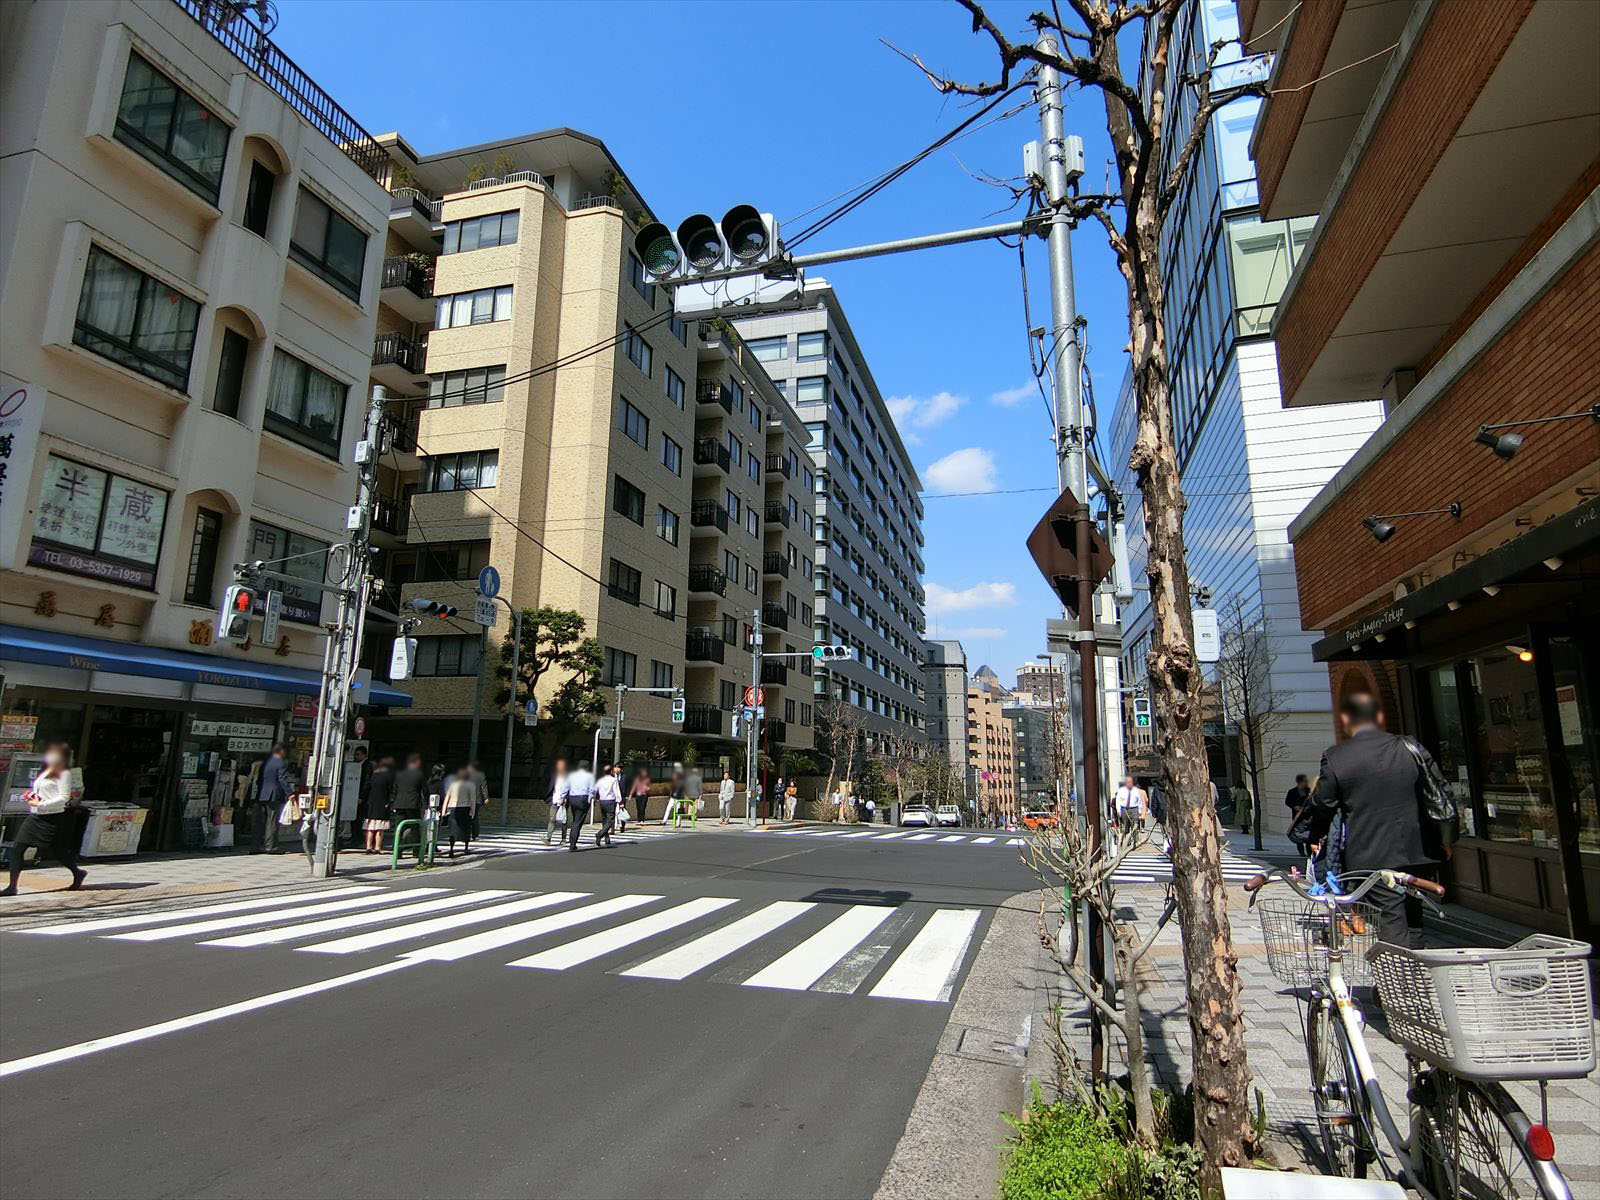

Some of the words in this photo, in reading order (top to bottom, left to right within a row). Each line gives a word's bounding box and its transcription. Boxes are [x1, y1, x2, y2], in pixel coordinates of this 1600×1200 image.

[55, 468, 90, 501] 半
[120, 487, 155, 523] 蔵
[44, 550, 63, 566] TEL
[69, 557, 142, 582] 03-5357-1929
